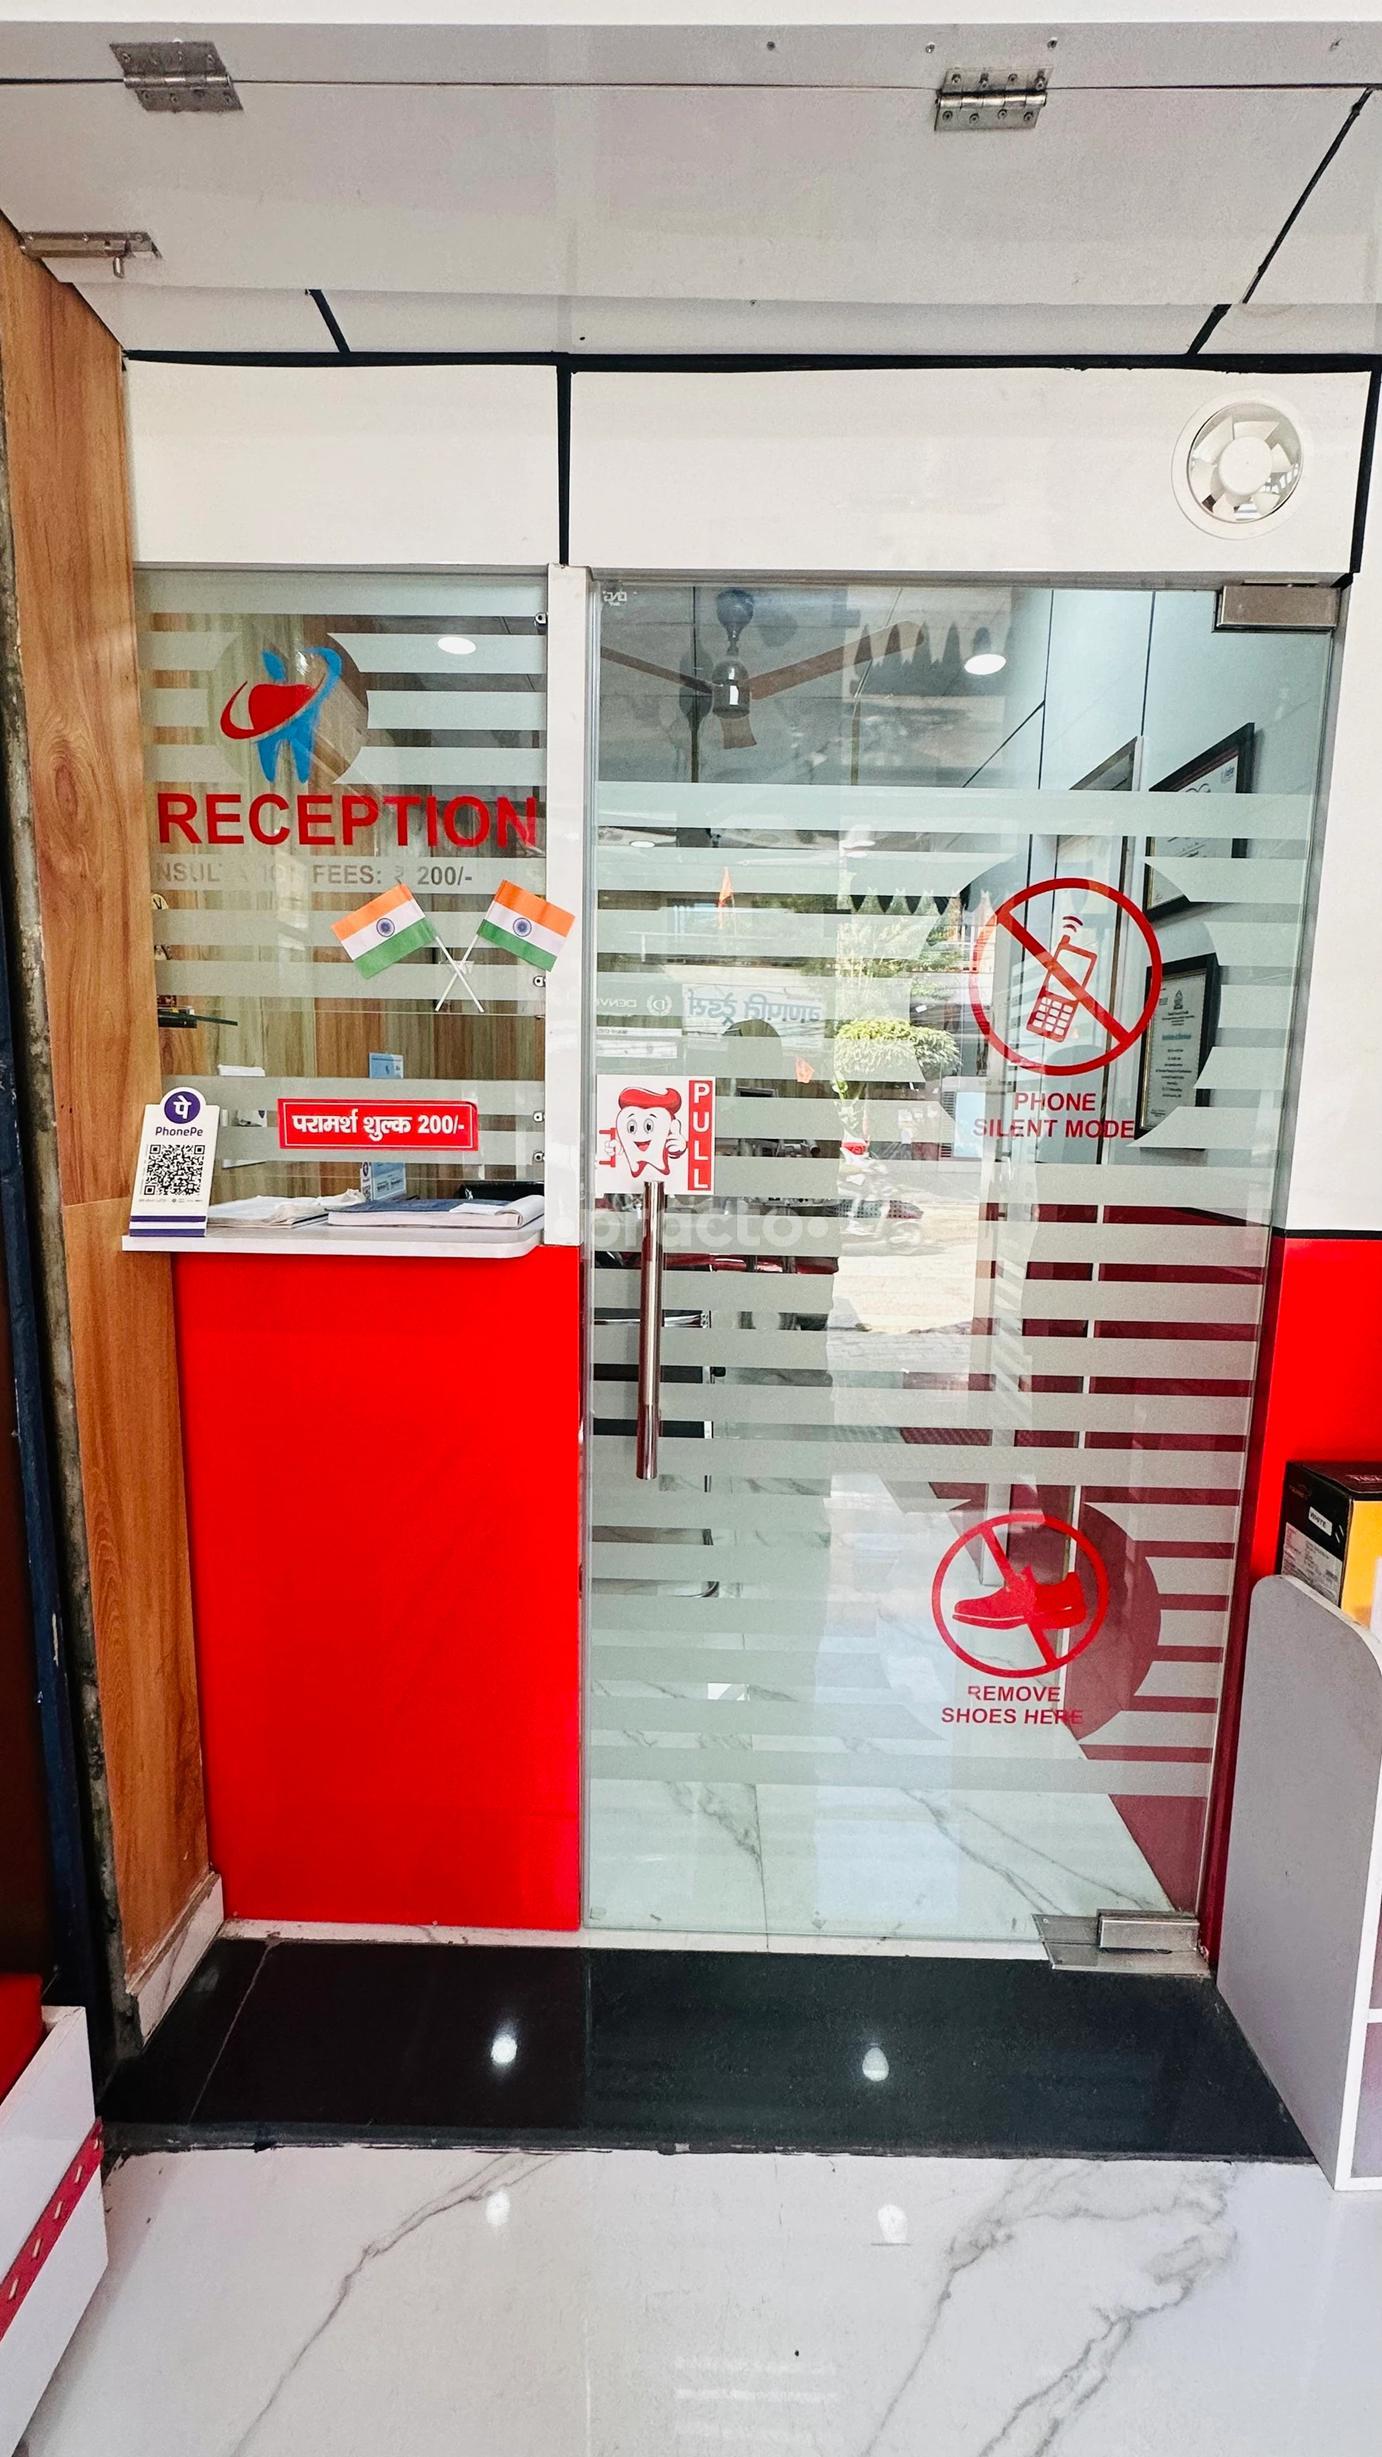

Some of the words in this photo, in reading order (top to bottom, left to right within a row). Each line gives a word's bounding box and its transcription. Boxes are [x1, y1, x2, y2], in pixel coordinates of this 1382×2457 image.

[156, 793, 537, 848] RECEPTION
[311, 864, 382, 885] FEES:
[416, 865, 473, 886] 200/-
[1014, 1093, 1096, 1112] PHONE
[155, 1126, 204, 1137] PhonePe
[291, 1108, 359, 1134] परामर्श
[363, 1115, 413, 1142] शुल्क
[417, 1115, 465, 1135] 200/-
[973, 1119, 1059, 1138] SILENT
[1065, 1119, 1135, 1139] MODE
[692, 1083, 711, 1189] PULL
[1309, 1511, 1328, 1529] WHITE
[967, 1685, 1062, 1703] REMOVE
[940, 1707, 1017, 1725] SHOES
[1023, 1708, 1084, 1726] HERE
